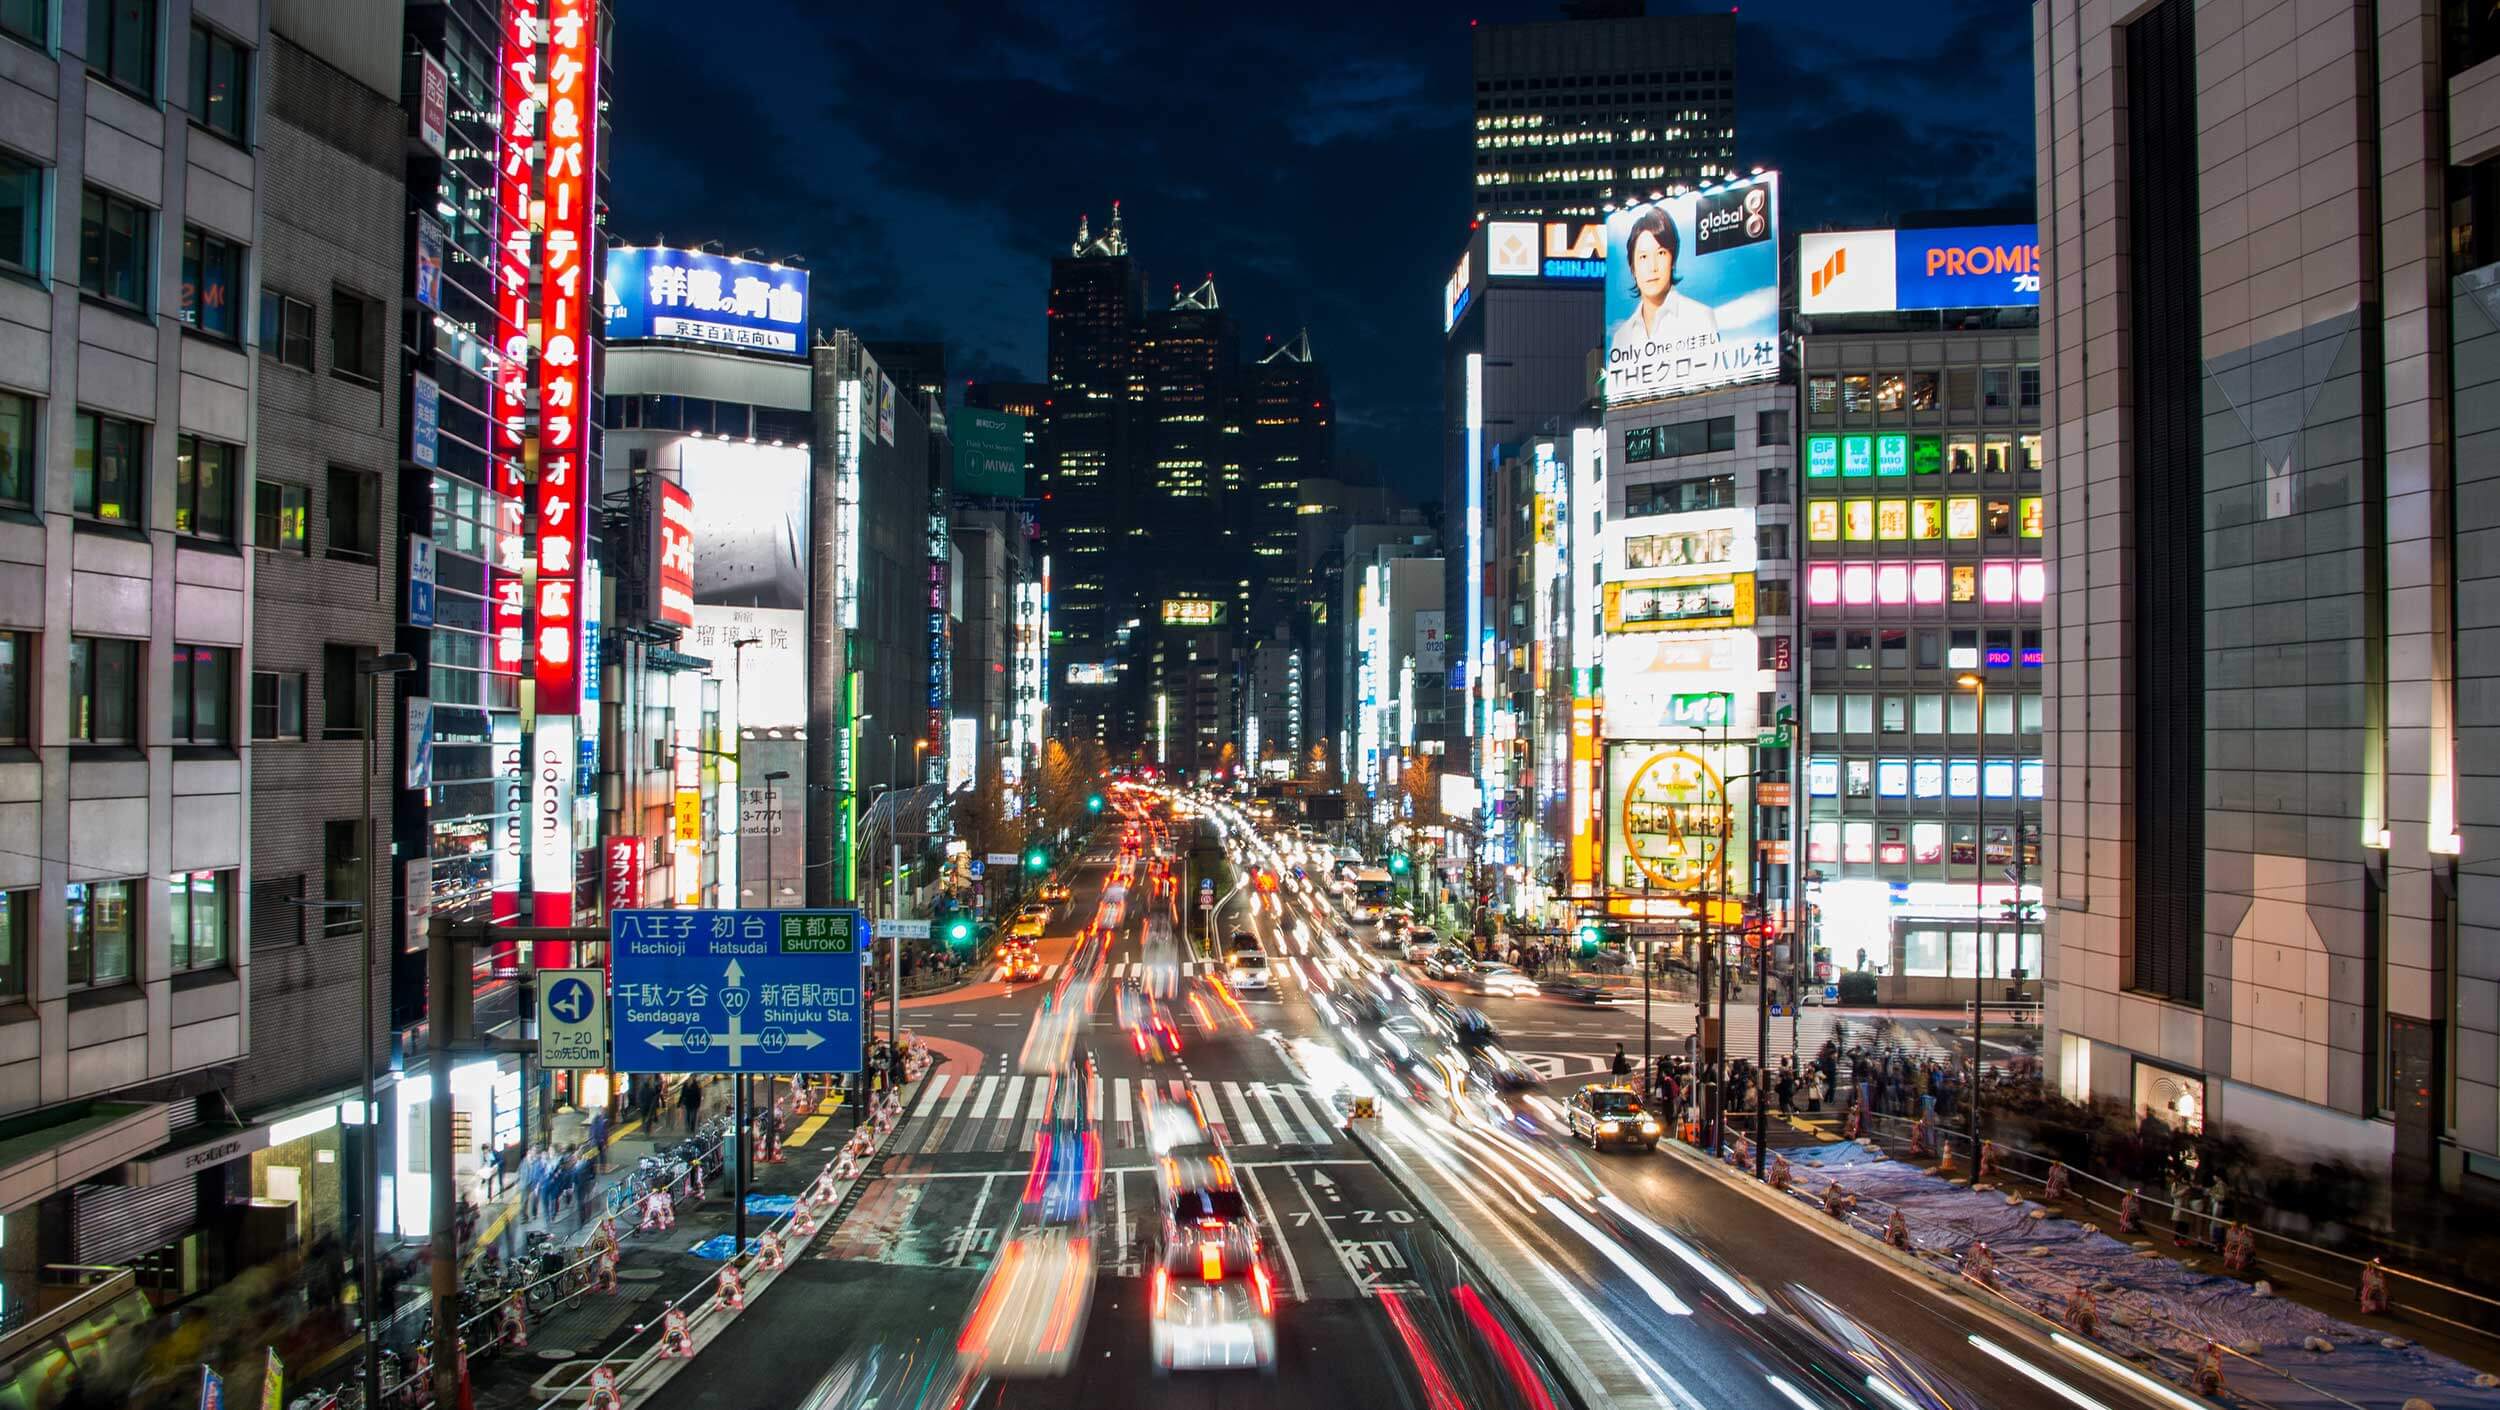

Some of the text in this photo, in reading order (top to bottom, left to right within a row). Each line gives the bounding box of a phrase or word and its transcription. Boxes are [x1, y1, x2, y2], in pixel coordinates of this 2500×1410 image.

[547, 0, 583, 329] オケ&パーティー
[1699, 205, 1744, 241] global
[649, 265, 802, 323] 洋服の青山
[676, 321, 779, 346] 京王百貨店向い
[1610, 347, 1642, 365] Only
[1645, 338, 1673, 357] One
[985, 459, 1016, 473] MIWA
[1989, 652, 2010, 663] PRO
[1674, 696, 1727, 721] レイク
[543, 750, 562, 856] docomo
[612, 842, 632, 909] カラオケ
[620, 916, 849, 939] 八王子 初台 首都高
[631, 939, 846, 957] Hachioji Hatsudai SHUTOKO
[726, 991, 744, 1008] 20
[760, 984, 856, 1008] 新宿駅西口
[627, 1009, 853, 1024] Sendagaya Shinjuku Sta.
[545, 1046, 600, 1060] この先50m
[687, 1034, 784, 1048] 414 414
